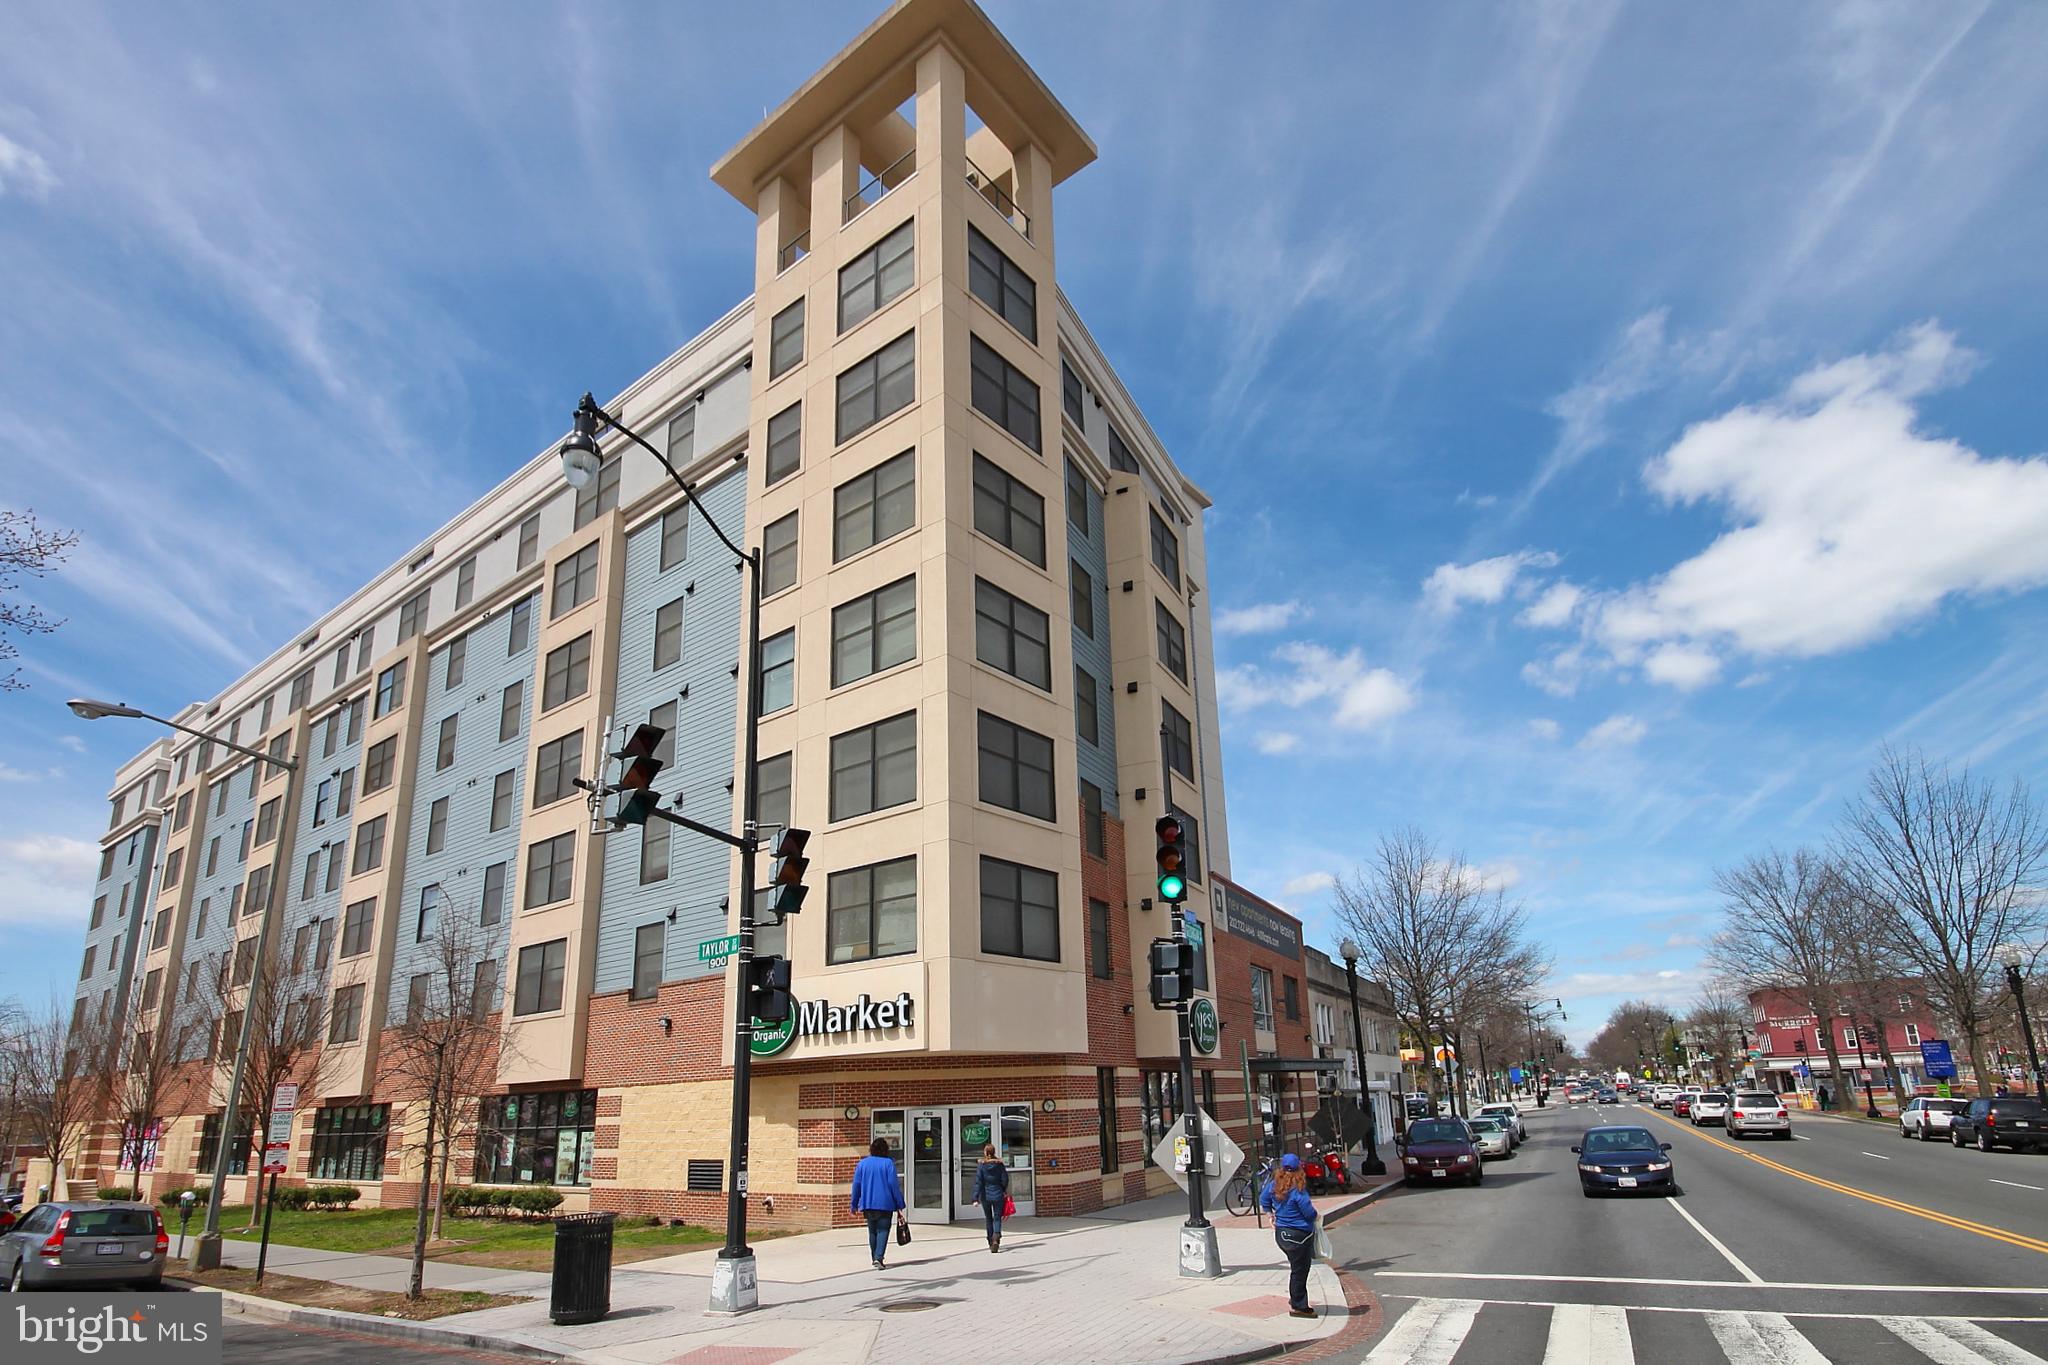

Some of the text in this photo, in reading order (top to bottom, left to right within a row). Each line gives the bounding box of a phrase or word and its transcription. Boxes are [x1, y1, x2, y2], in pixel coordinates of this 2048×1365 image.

[702, 940, 729, 958] TAYLOR
[710, 956, 727, 968] 900
[753, 1029, 786, 1043] Organic
